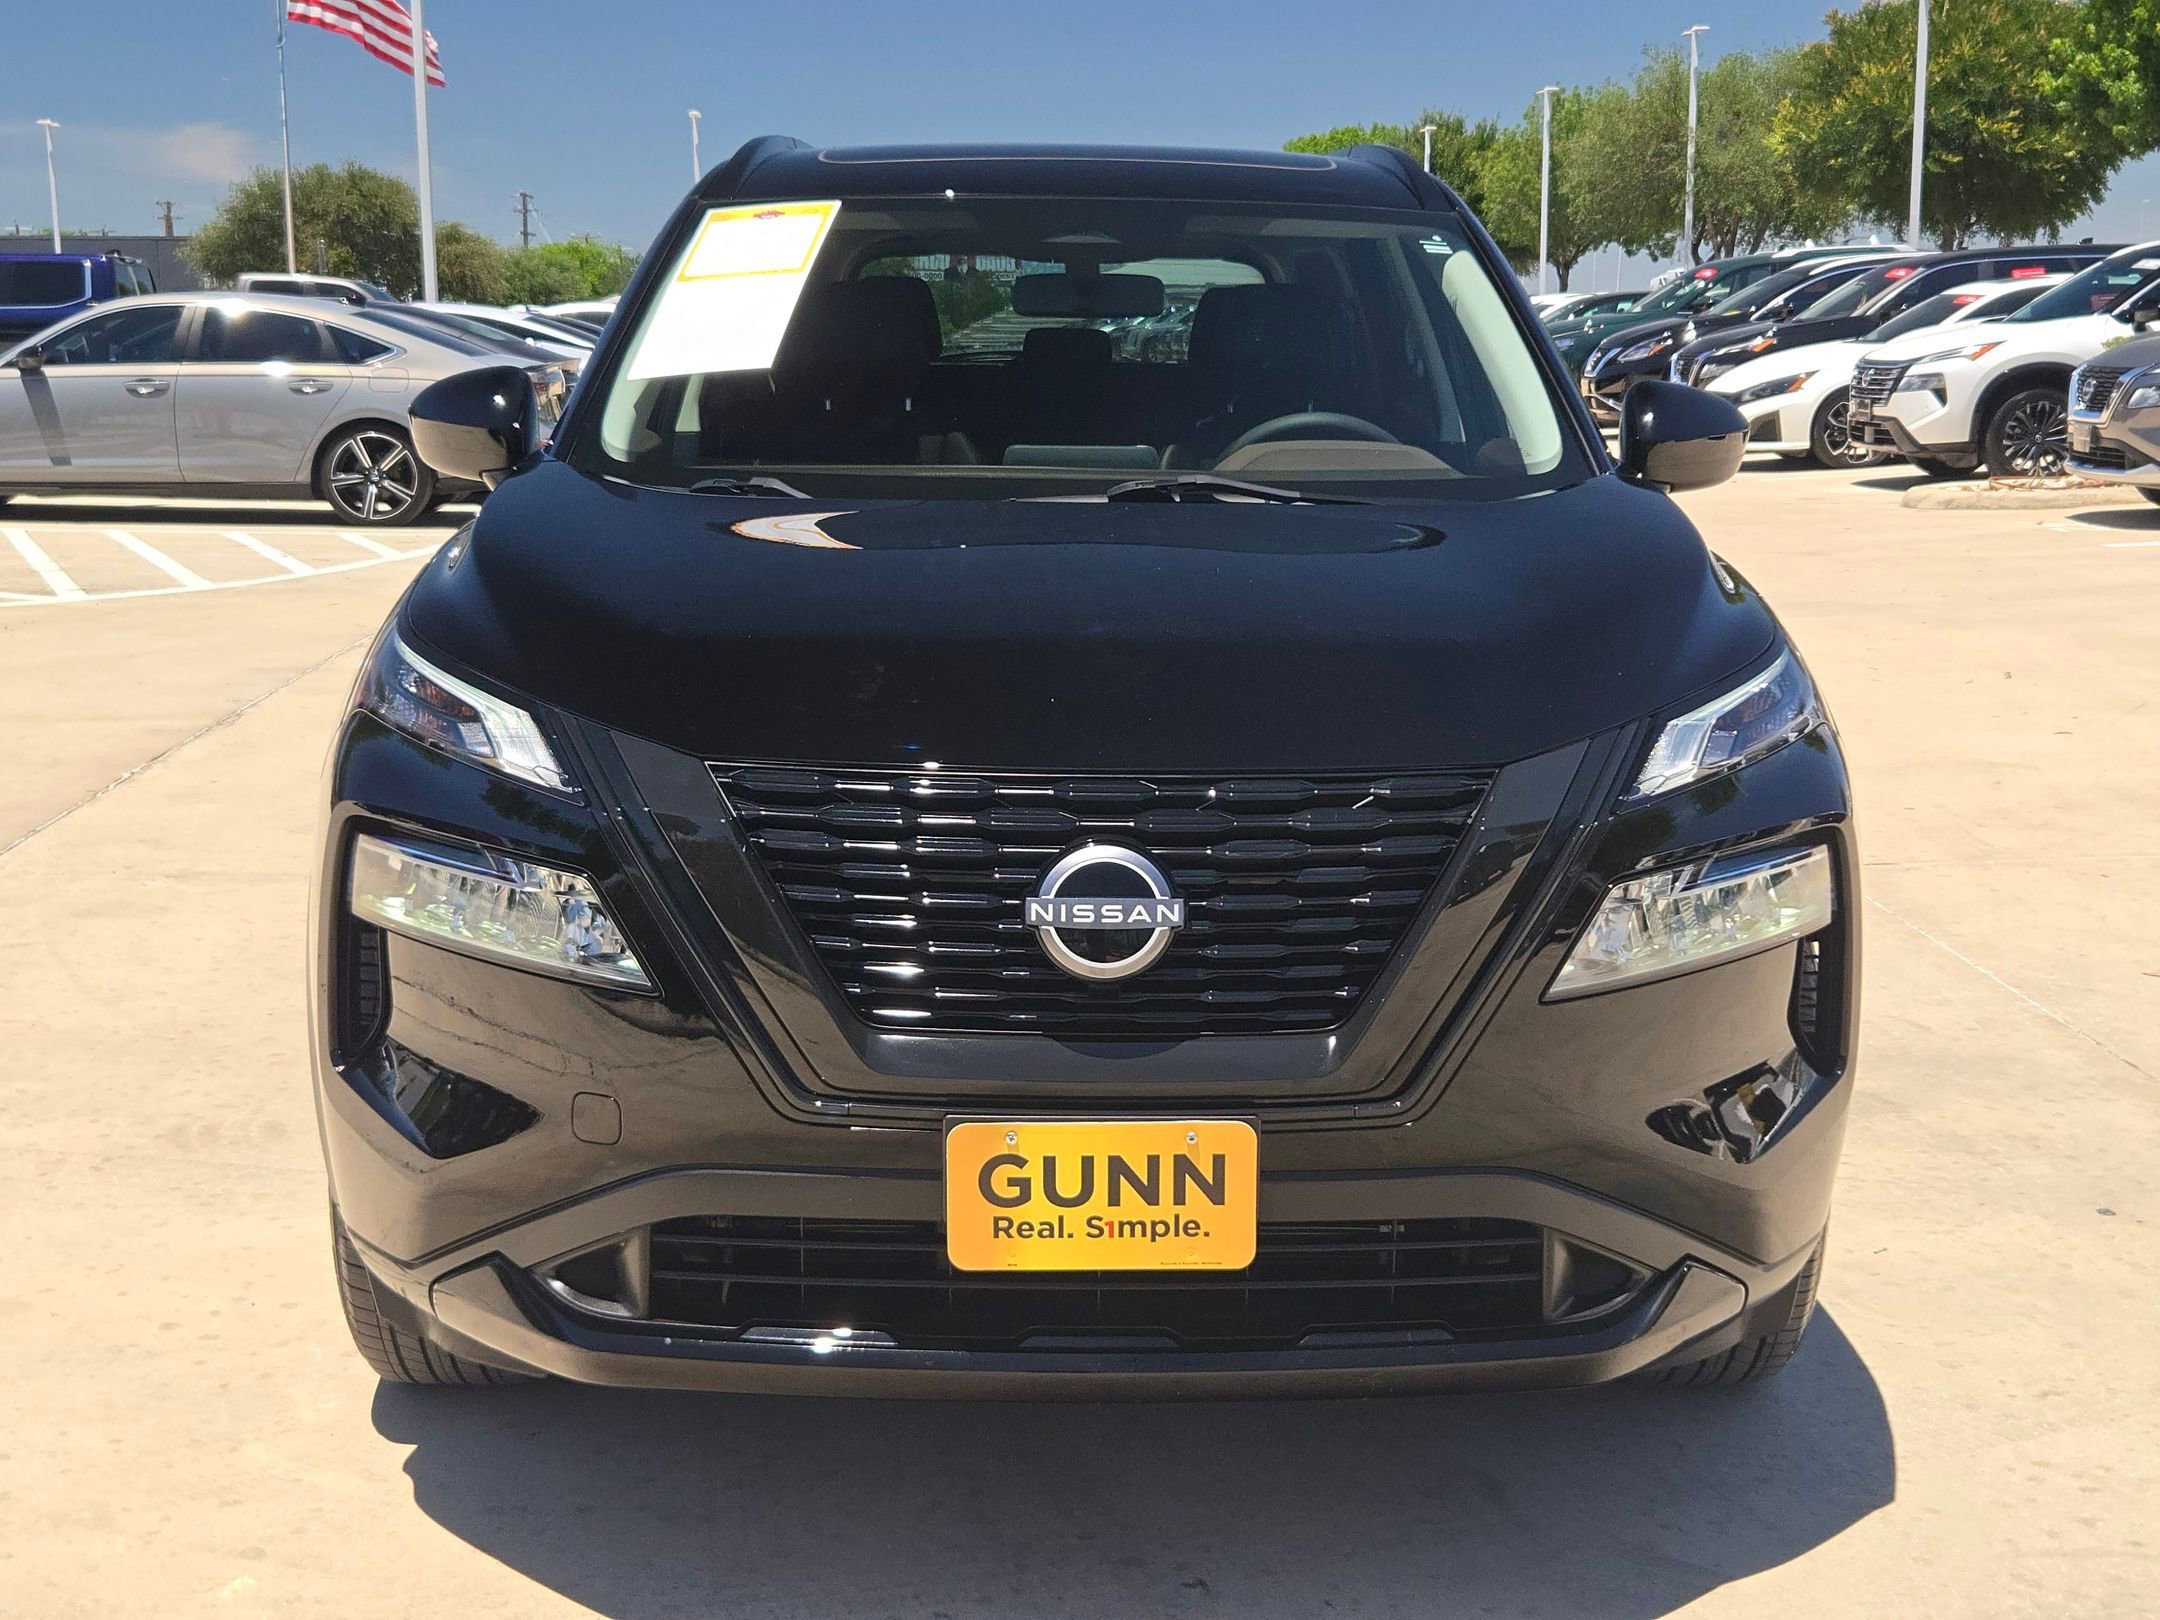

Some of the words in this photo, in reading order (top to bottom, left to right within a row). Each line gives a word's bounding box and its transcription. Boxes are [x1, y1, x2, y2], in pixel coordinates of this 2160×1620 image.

[1030, 902, 1180, 924] NISSAN
[977, 1152, 1227, 1209] GUNN
[992, 1214, 1075, 1240] Real.
